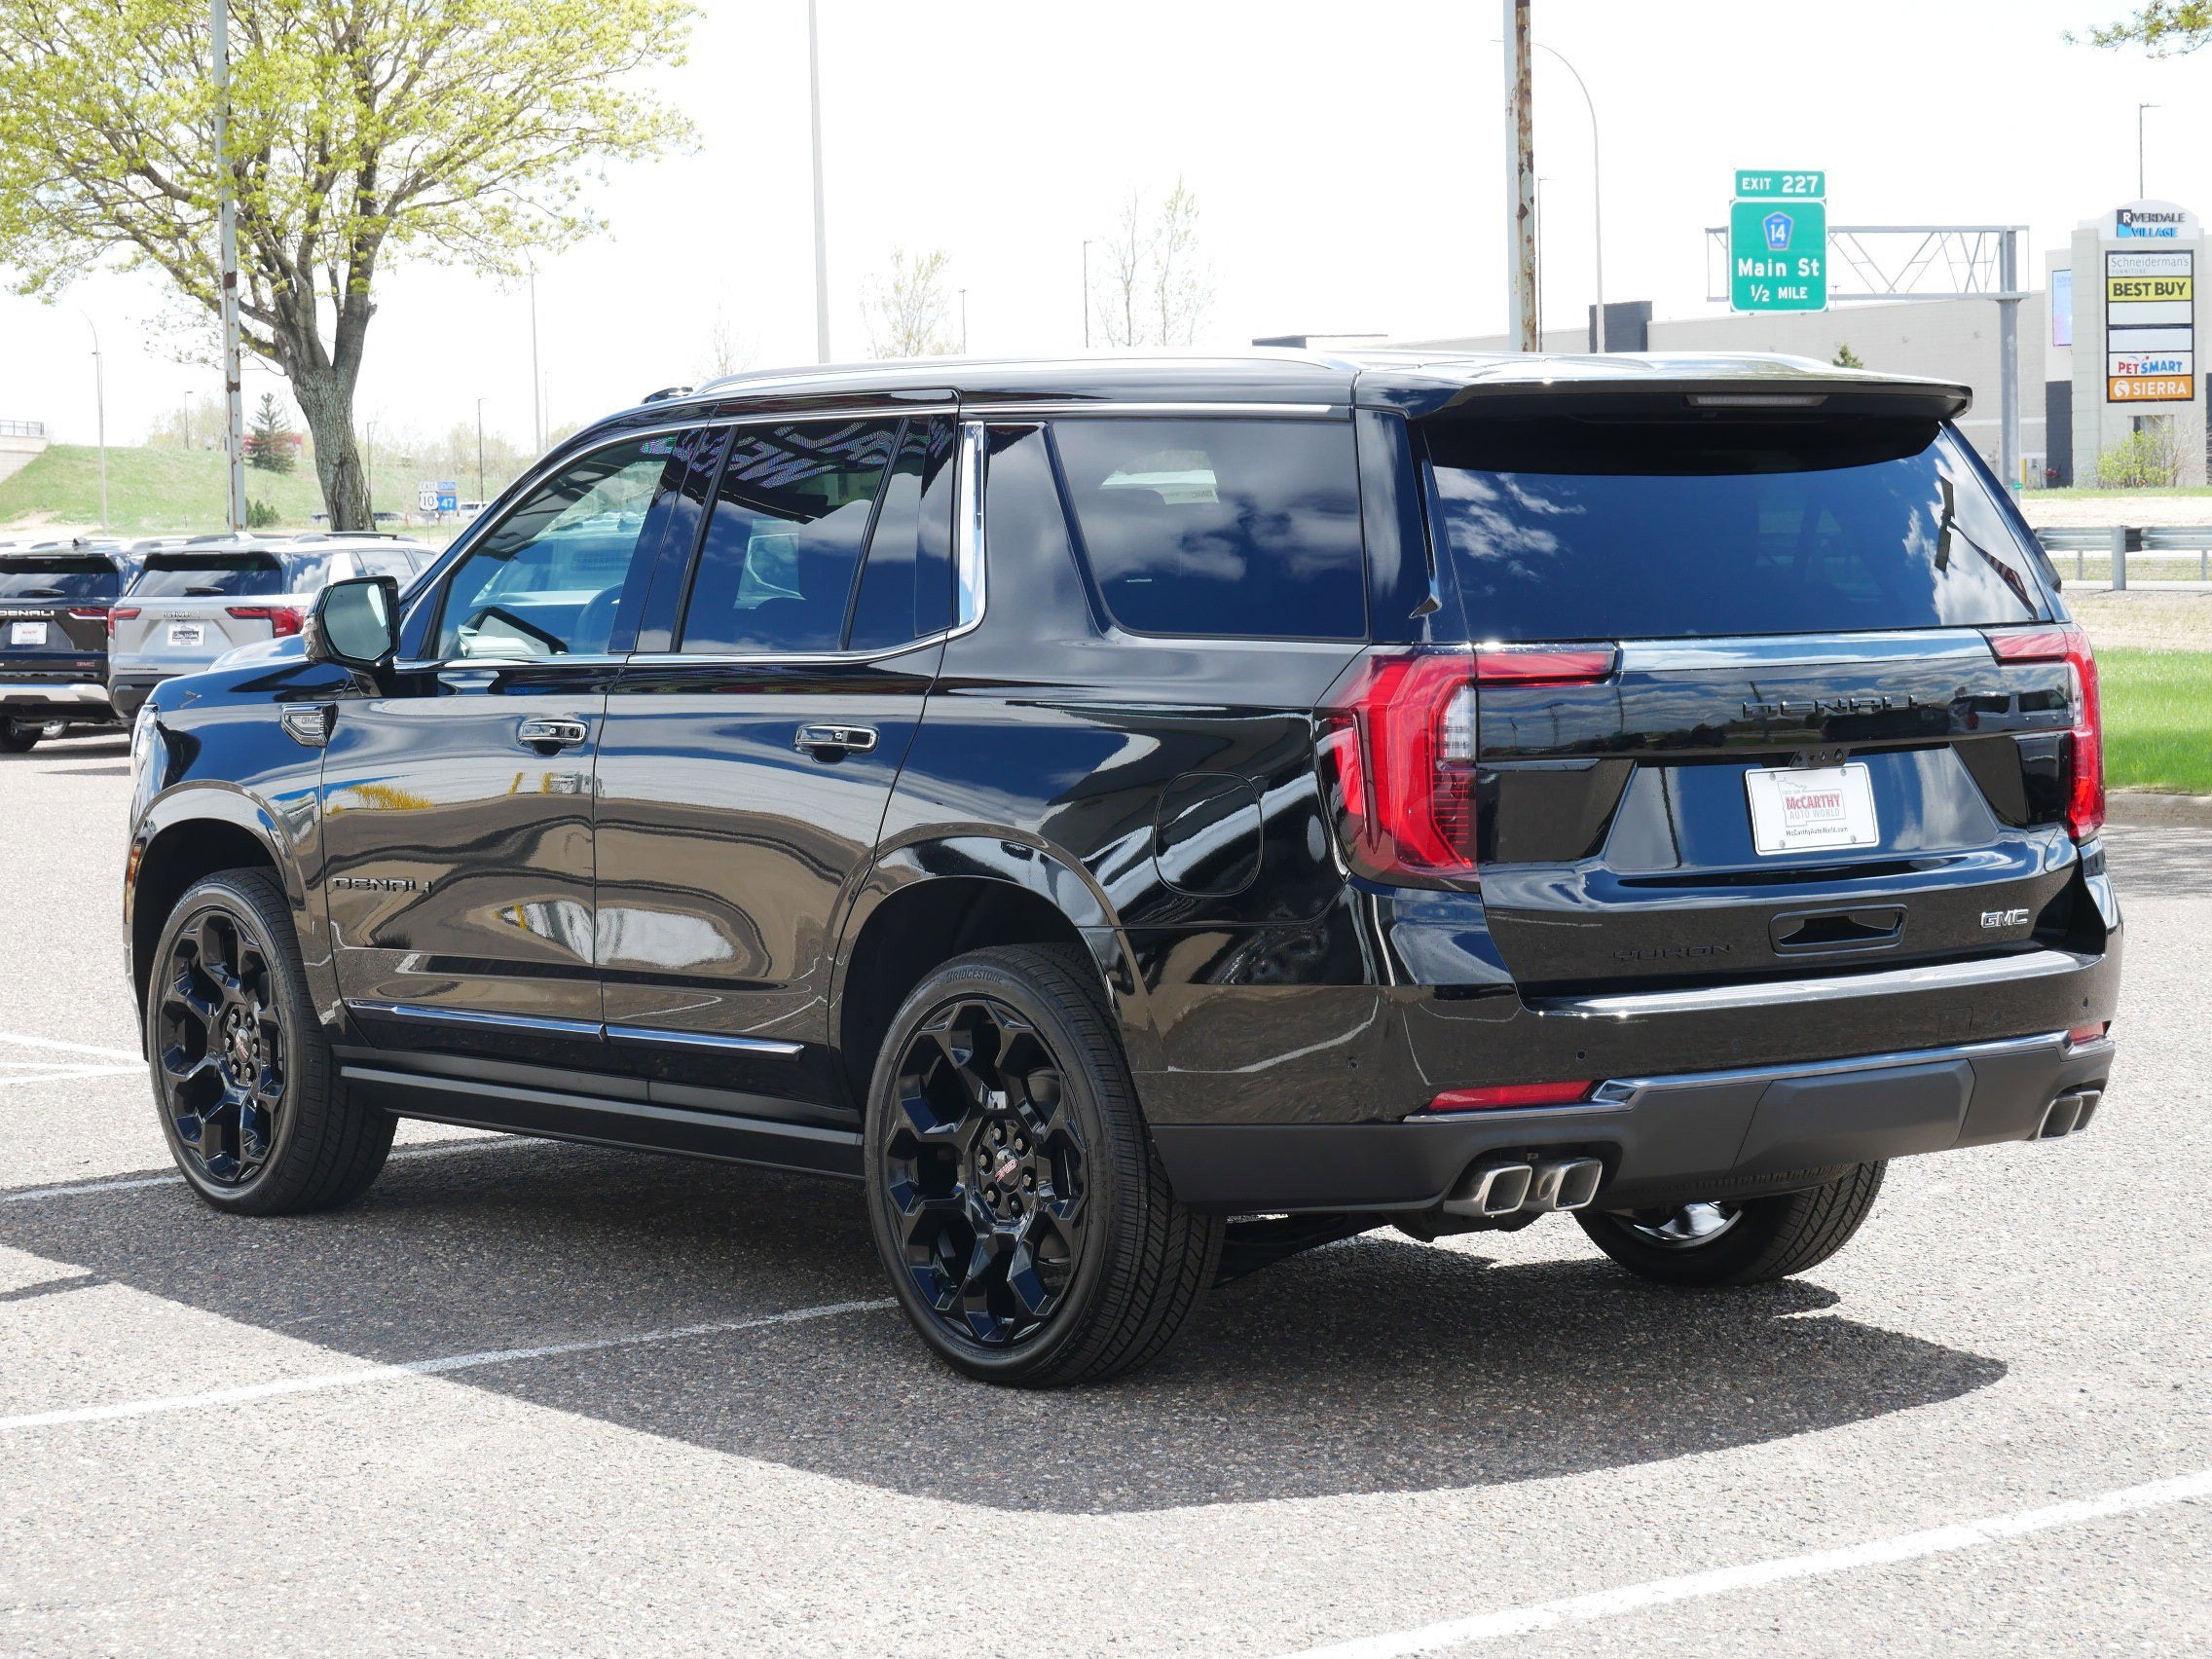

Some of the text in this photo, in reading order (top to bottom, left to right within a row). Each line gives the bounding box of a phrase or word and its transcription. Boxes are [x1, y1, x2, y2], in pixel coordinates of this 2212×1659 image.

[1742, 175, 1819, 194] EXIT 227
[2122, 211, 2186, 223] RIVERDALE
[1770, 224, 1786, 241] 14
[2131, 226, 2179, 238] VILLAGE
[1738, 258, 1820, 277] Main St
[2111, 256, 2190, 268] Schneiderman's
[1778, 287, 1808, 300] MILE
[2113, 281, 2187, 297] BEST BUY
[2132, 382, 2188, 395] SIERRA
[424, 496, 435, 507] 10
[441, 498, 455, 508] 47
[1742, 694, 1917, 719] DENALI
[1786, 793, 1840, 810] McCARTHY
[1789, 808, 1840, 820] AUTO WORLD
[332, 877, 432, 893] DENALI
[1980, 908, 2030, 929] GMC
